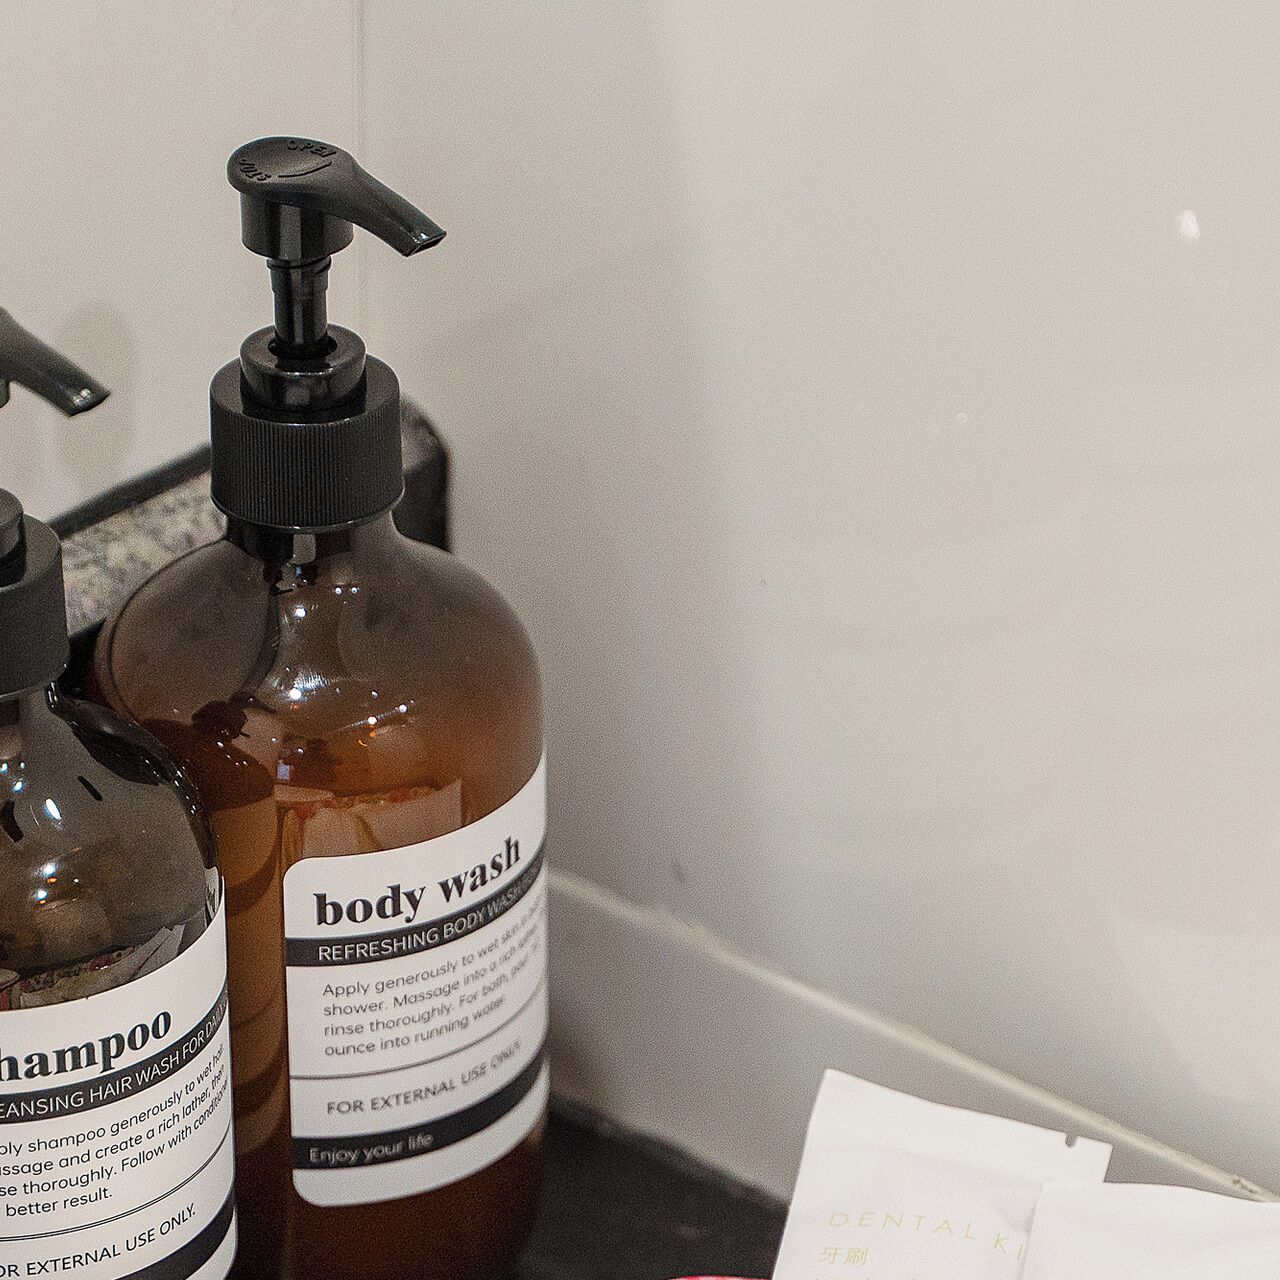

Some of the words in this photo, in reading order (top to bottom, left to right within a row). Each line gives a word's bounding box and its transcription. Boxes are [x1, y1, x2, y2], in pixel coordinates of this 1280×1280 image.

[314, 885, 425, 926] body
[438, 835, 521, 902] wash
[318, 929, 440, 962] REFRESHING
[443, 907, 486, 939] BODY
[487, 887, 521, 918] WASH
[322, 981, 369, 998] Apply
[374, 959, 458, 995] generously
[461, 952, 474, 967] to
[477, 937, 499, 959] wet
[323, 1000, 388, 1018] shower.
[393, 978, 460, 1008] Massage
[463, 966, 487, 987] into
[324, 1021, 363, 1036] rinse
[369, 1002, 457, 1034] thoroughly.
[459, 988, 479, 1005] For
[324, 1042, 376, 1057] ounce
[380, 1034, 410, 1050] into
[414, 1016, 469, 1046] running
[89, 1075, 132, 1104] HAIR
[134, 1053, 181, 1092] WASH
[182, 1029, 206, 1061] FOR
[326, 1099, 364, 1116] FOR
[370, 1078, 457, 1114] EXTERNAL
[460, 1063, 486, 1086] USE
[28, 1126, 106, 1154] shampoo
[110, 1089, 184, 1138] generously
[184, 1081, 196, 1094] to
[196, 1061, 213, 1085] wet
[59, 1148, 91, 1169] and
[95, 1132, 143, 1161] create
[146, 1127, 155, 1140] a
[158, 1112, 180, 1134] rich
[182, 1087, 211, 1120] lather,
[22, 1166, 119, 1197] thoroughly.
[121, 1142, 166, 1173] Follow
[167, 1125, 193, 1150] with
[309, 1146, 358, 1166] Enjoy
[363, 1141, 403, 1162] your
[407, 1133, 433, 1151] life
[5, 1198, 58, 1218] better
[62, 1187, 113, 1210] result.
[26, 1244, 122, 1277] EXTERNAL
[125, 1227, 157, 1252] USE
[158, 1201, 197, 1237] ONLY.
[817, 1245, 870, 1266] 牙刷
[827, 1210, 976, 1241] DENTAL
[993, 1232, 1024, 1260] KI
